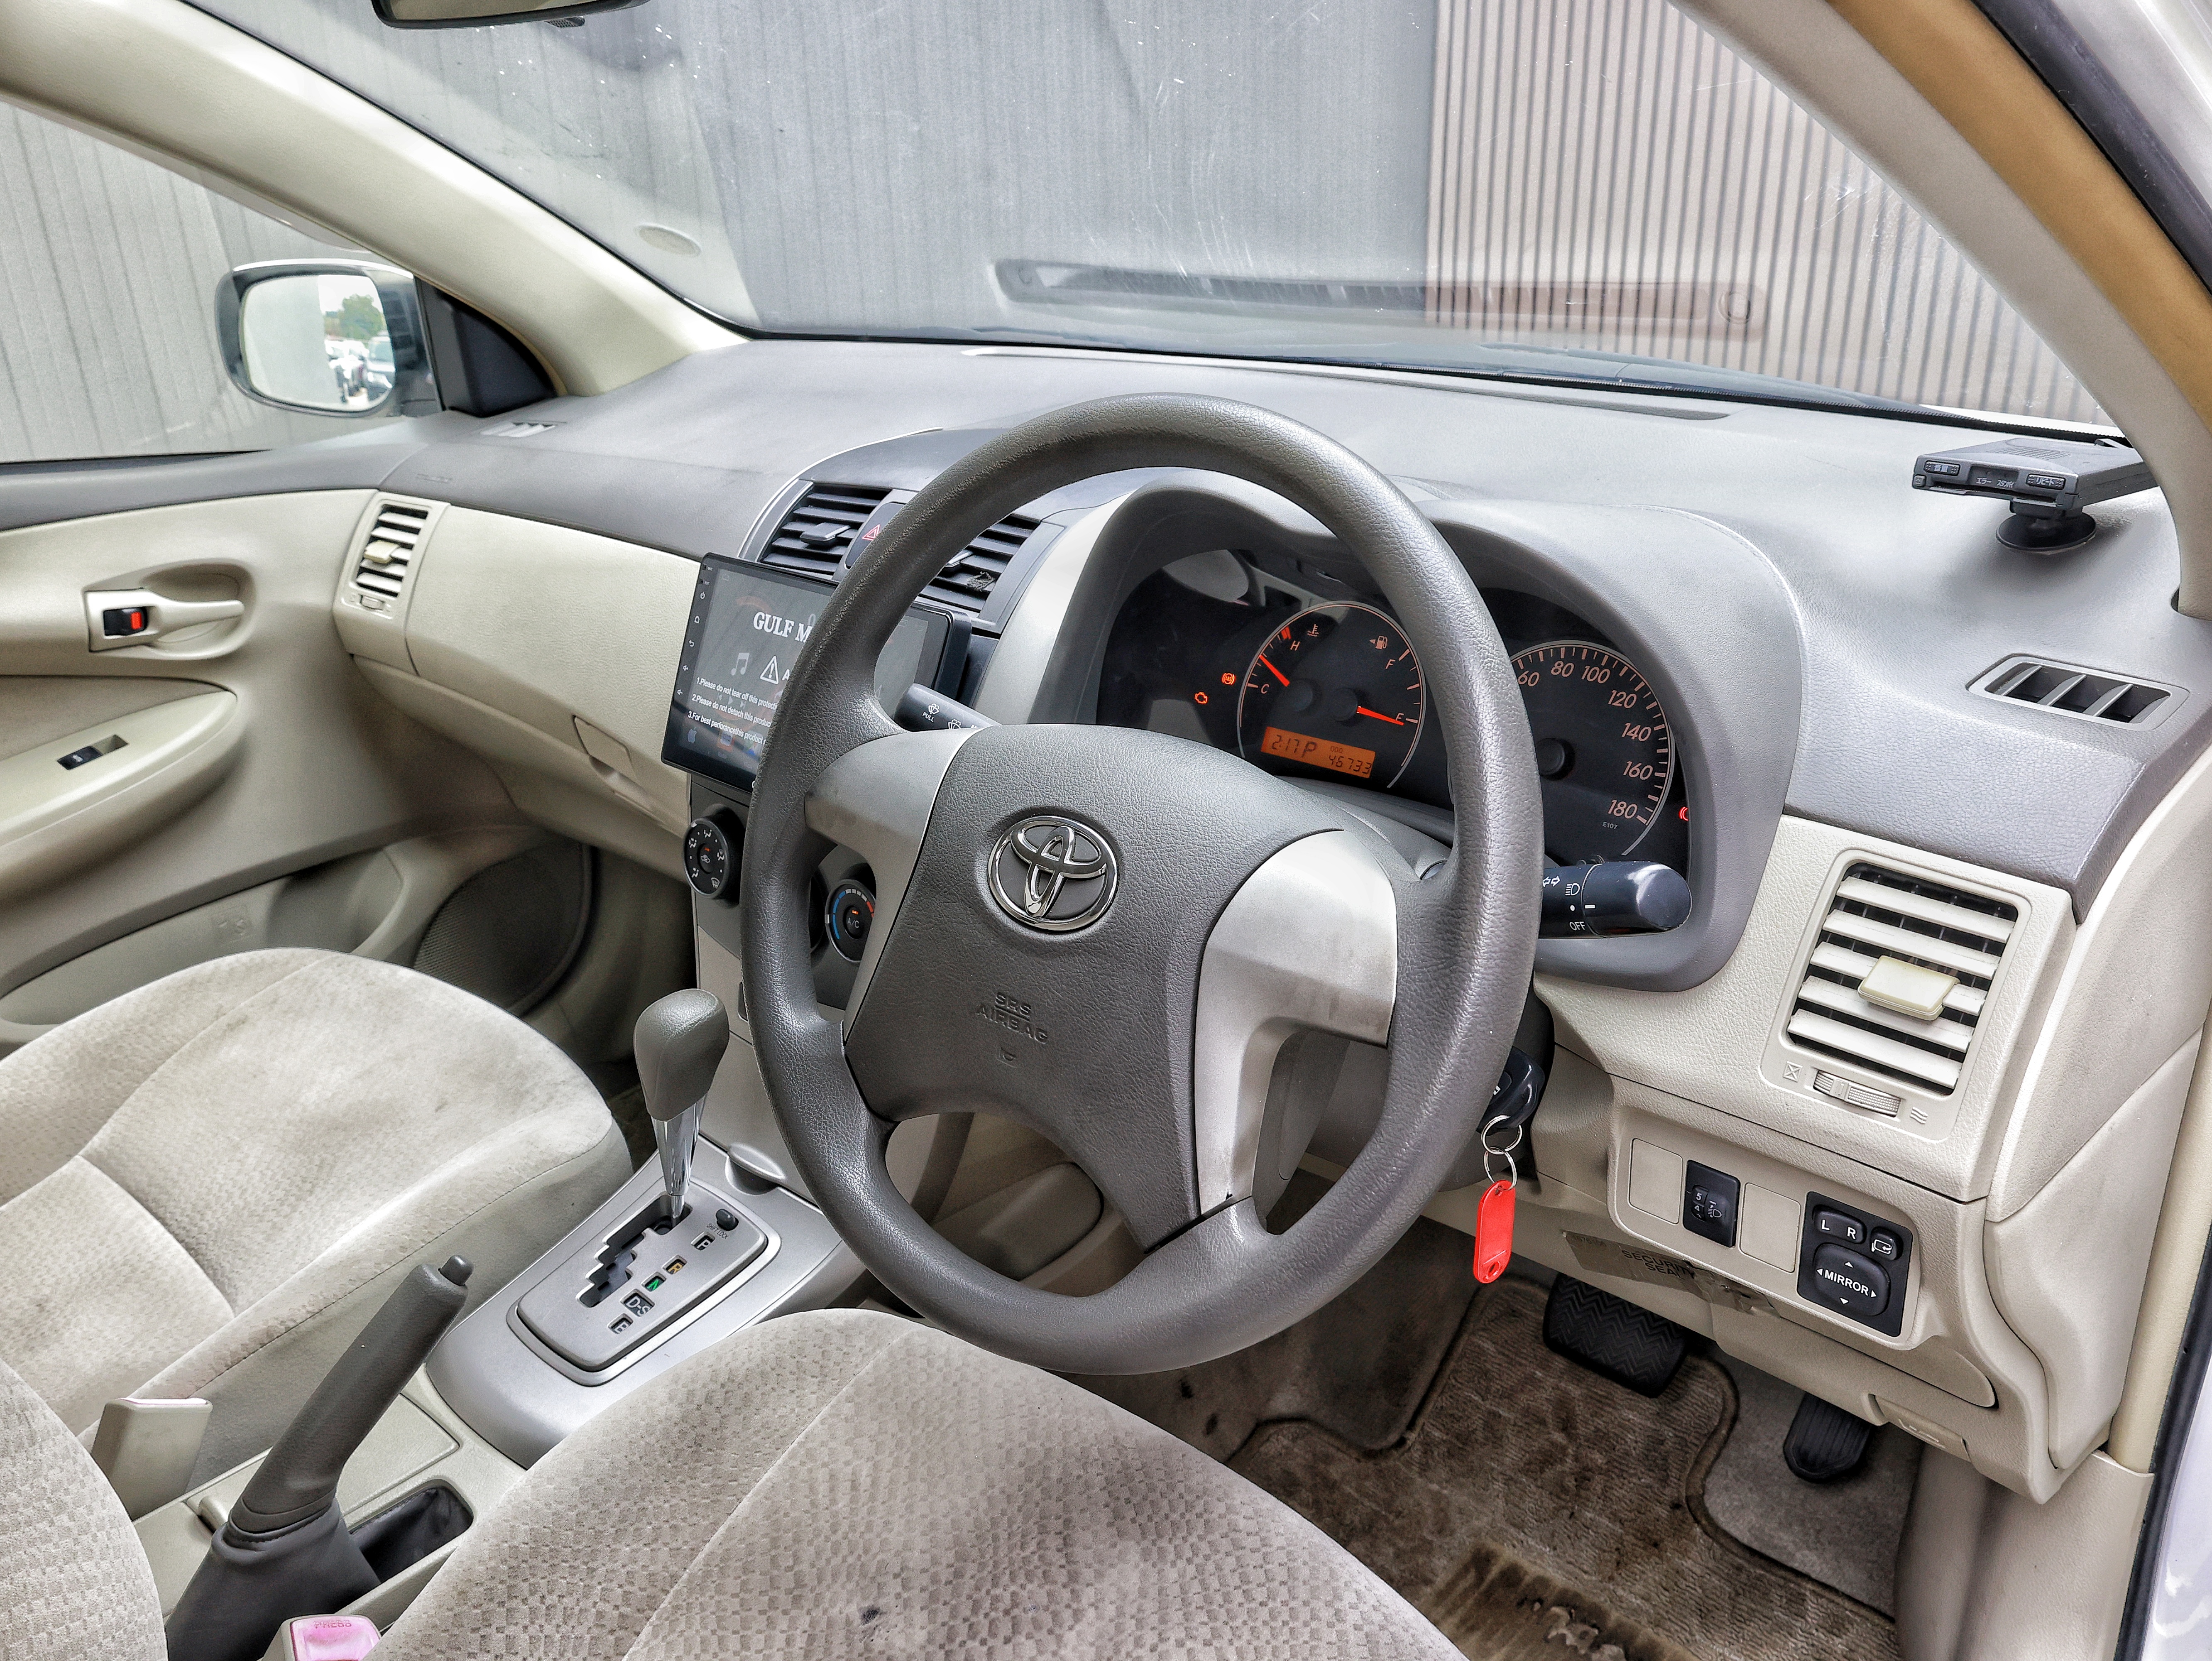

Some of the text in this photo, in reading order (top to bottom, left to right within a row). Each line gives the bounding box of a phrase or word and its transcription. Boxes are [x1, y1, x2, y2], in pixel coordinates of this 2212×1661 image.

[753, 612, 813, 643] GULF M
[1290, 640, 1301, 651] H
[1385, 659, 1396, 669] F
[1551, 660, 1574, 677] 80
[1517, 670, 1540, 687] 60
[1581, 665, 1610, 684] 100
[697, 677, 716, 690] 1.Please
[716, 684, 723, 692] do
[723, 687, 732, 696] not
[732, 690, 741, 698] tear
[1261, 684, 1270, 694] C
[1608, 689, 1637, 708] 120
[692, 694, 712, 706] 2.Please
[712, 701, 719, 710] do
[719, 704, 727, 713] not
[727, 708, 744, 719] detach
[744, 712, 754, 722] this
[922, 711, 934, 722] PULL
[688, 710, 701, 722] 3.For
[744, 732, 764, 744] product
[1621, 722, 1652, 742] 140
[1329, 755, 1372, 774] 46733
[1623, 761, 1653, 780] 160
[1608, 799, 1638, 819] 180
[1602, 821, 1618, 830] E107
[847, 917, 859, 928] A/C
[1569, 921, 1585, 931] OFF
[994, 994, 1031, 1017] SRS
[977, 1004, 1048, 1044] AIRBAG
[1696, 1192, 1702, 1200] 5
[707, 1223, 729, 1240] SHIFT LOCK
[1821, 1219, 1830, 1230] L
[1847, 1227, 1856, 1240] R
[696, 1239, 711, 1248] P
[668, 1262, 683, 1274] R
[1622, 1250, 1695, 1279] SECURITY
[1824, 1269, 1869, 1296] MIRROR
[313, 1620, 352, 1629] PRESS
